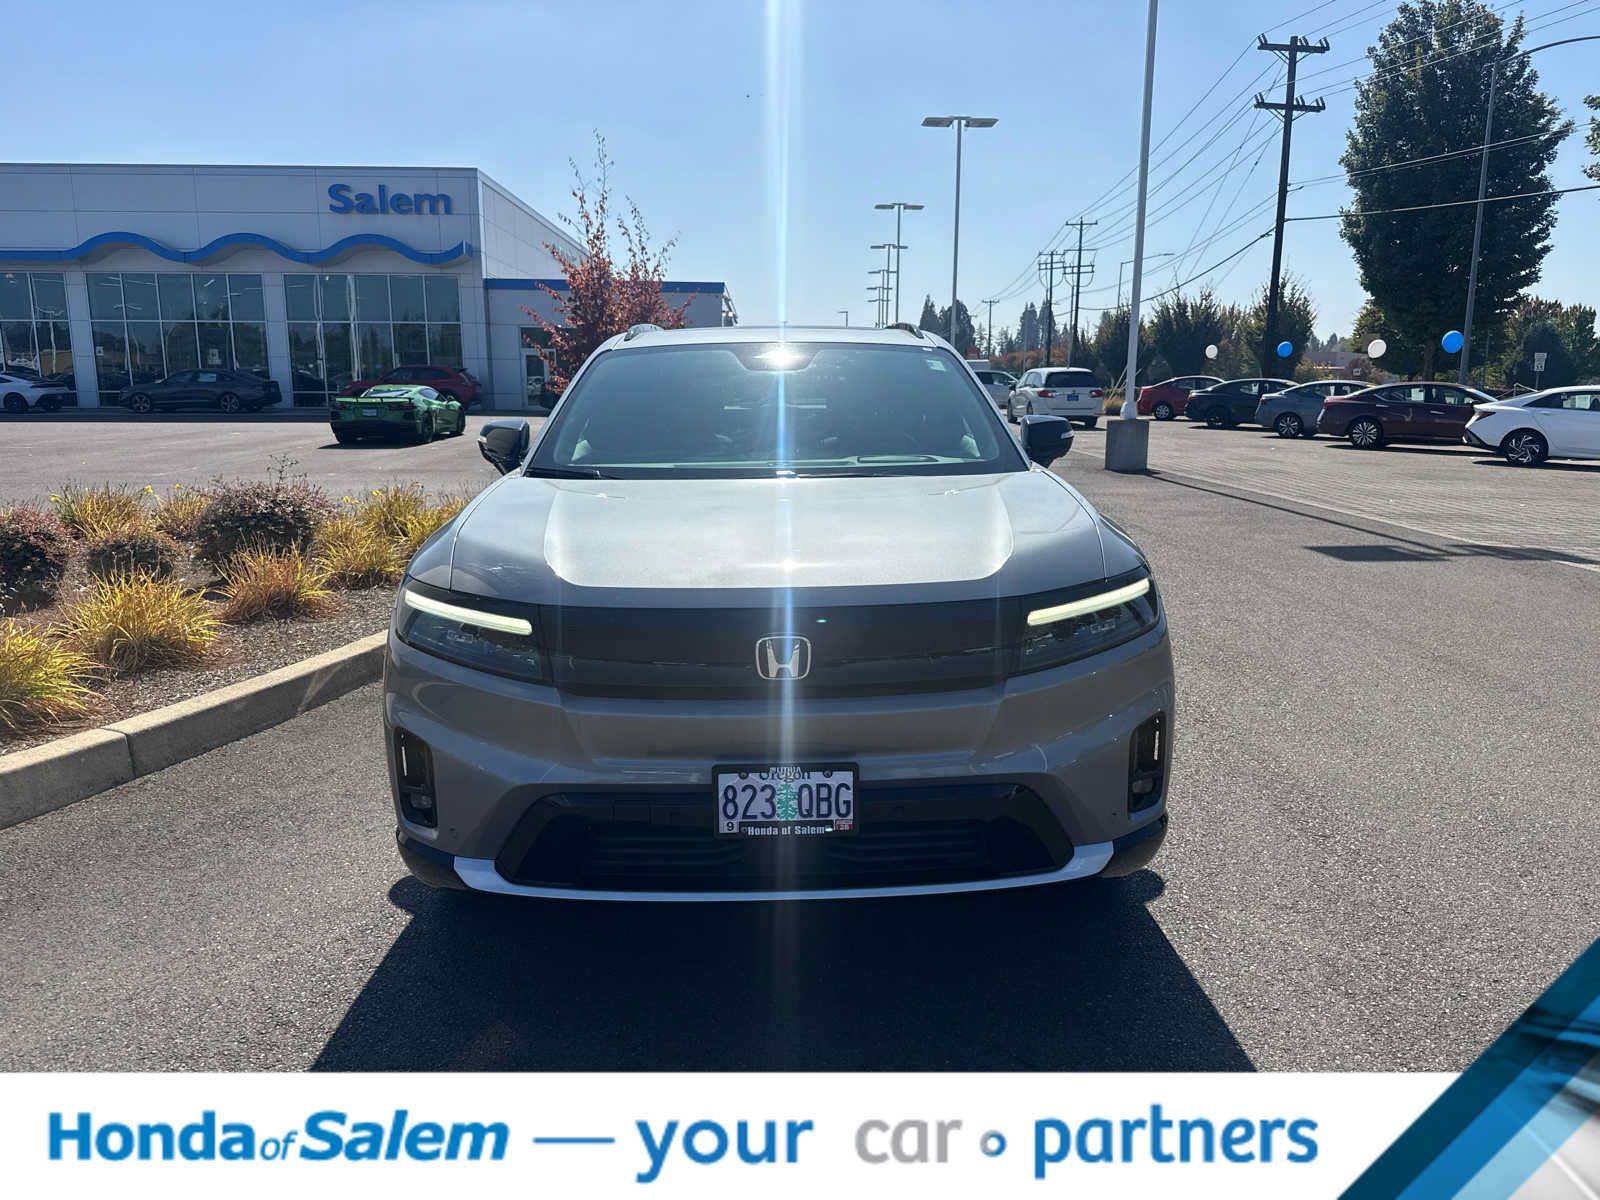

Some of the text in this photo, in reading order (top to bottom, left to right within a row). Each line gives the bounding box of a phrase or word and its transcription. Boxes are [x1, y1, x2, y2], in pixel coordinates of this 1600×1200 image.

[327, 183, 453, 215] Salem
[722, 783, 852, 820] 823 QBG
[726, 821, 735, 832] 9
[747, 825, 825, 836] Honda of Salem
